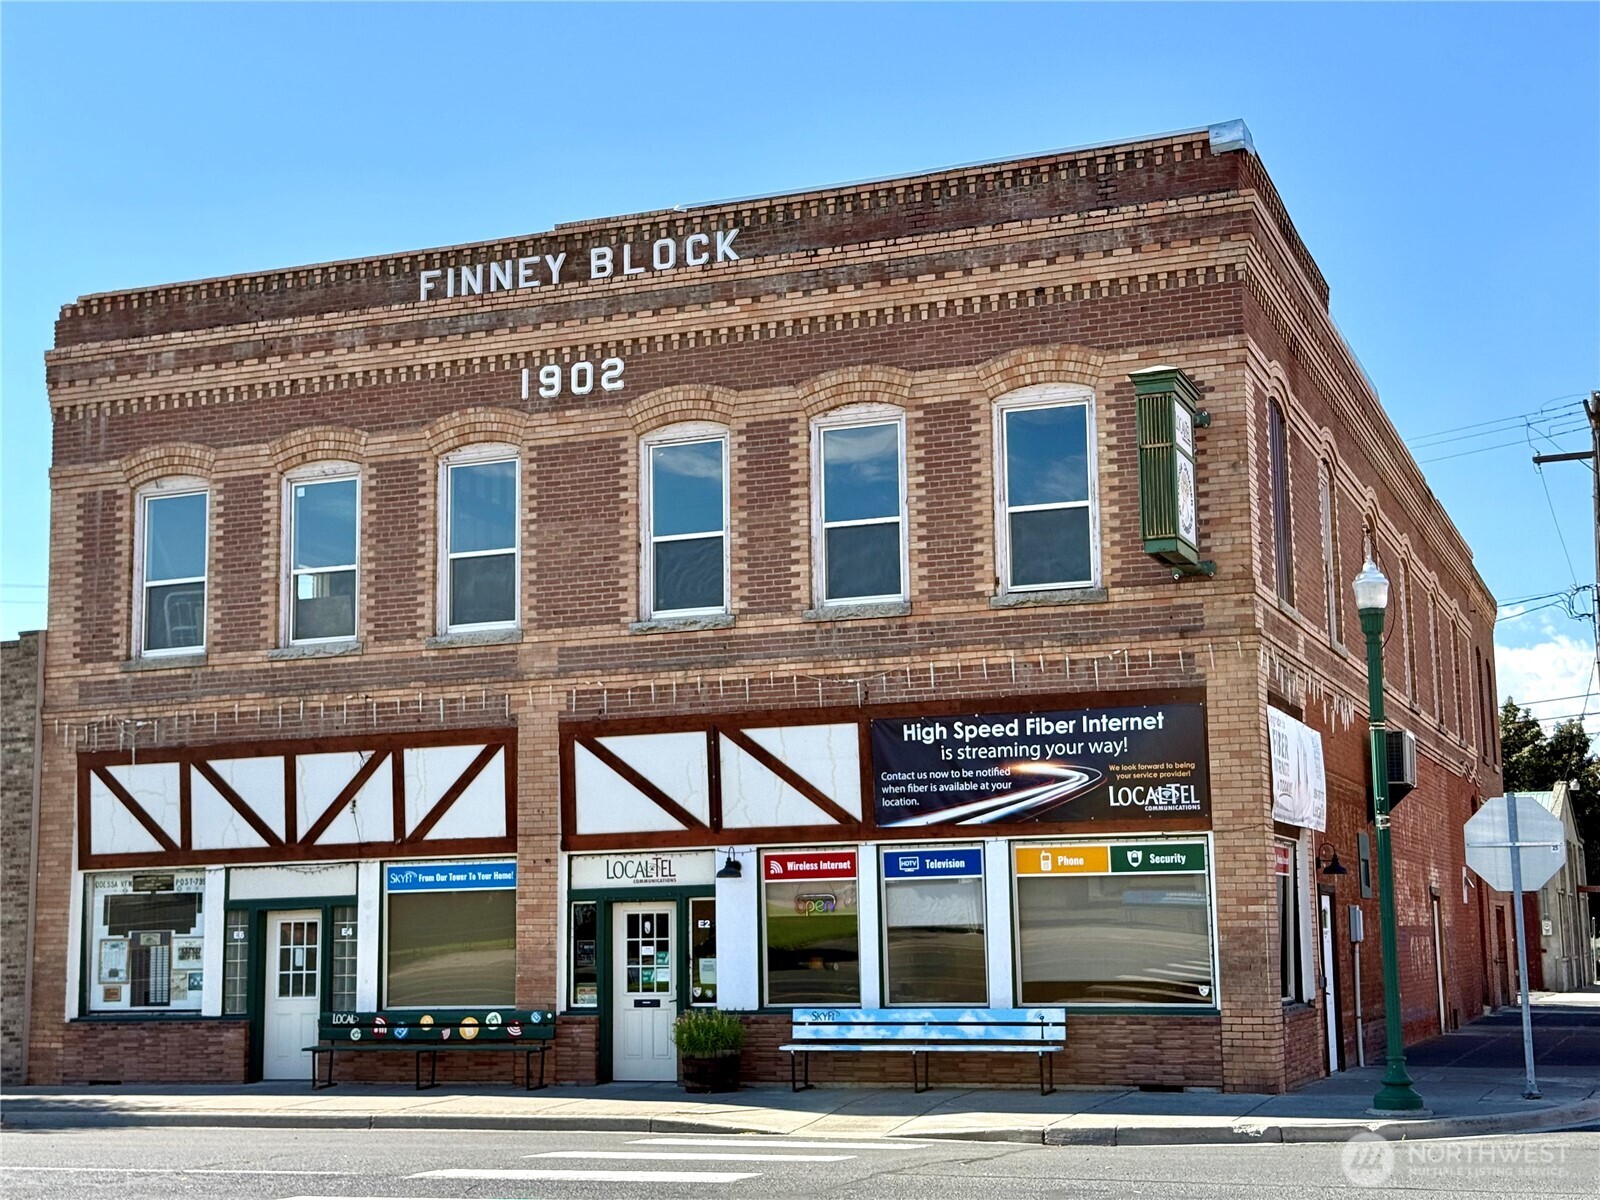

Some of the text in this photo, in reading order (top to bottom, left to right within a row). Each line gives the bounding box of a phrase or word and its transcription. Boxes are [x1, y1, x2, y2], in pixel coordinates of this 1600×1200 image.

[420, 228, 741, 301] FINNEY BLOCK
[521, 357, 625, 400] 1902
[903, 711, 1164, 744] High Speed Fiber Internet
[941, 737, 1128, 760] is streaming your way!
[1108, 761, 1195, 771] We look forward to being
[881, 767, 1011, 781] Contact us now to be notified
[1115, 770, 1191, 780] your service provider!
[881, 780, 1012, 793] when fiber is available at your
[882, 797, 920, 807] location.
[1144, 803, 1201, 811] COMMUNICATIONS
[901, 859, 917, 867] HDTV
[925, 858, 965, 869] Television
[1057, 855, 1084, 866] Phone
[1149, 852, 1186, 865] Security
[786, 859, 851, 870] Wireless Internet
[418, 873, 435, 882] From
[435, 873, 447, 881] Our
[448, 872, 468, 881] Tower
[468, 872, 477, 880] To
[477, 871, 492, 880] Your
[493, 870, 514, 880] Home!
[795, 899, 836, 917] open
[698, 920, 710, 928] E2
[233, 930, 245, 939] E6
[341, 927, 353, 936] E4
[332, 1013, 355, 1024] LOCAL
